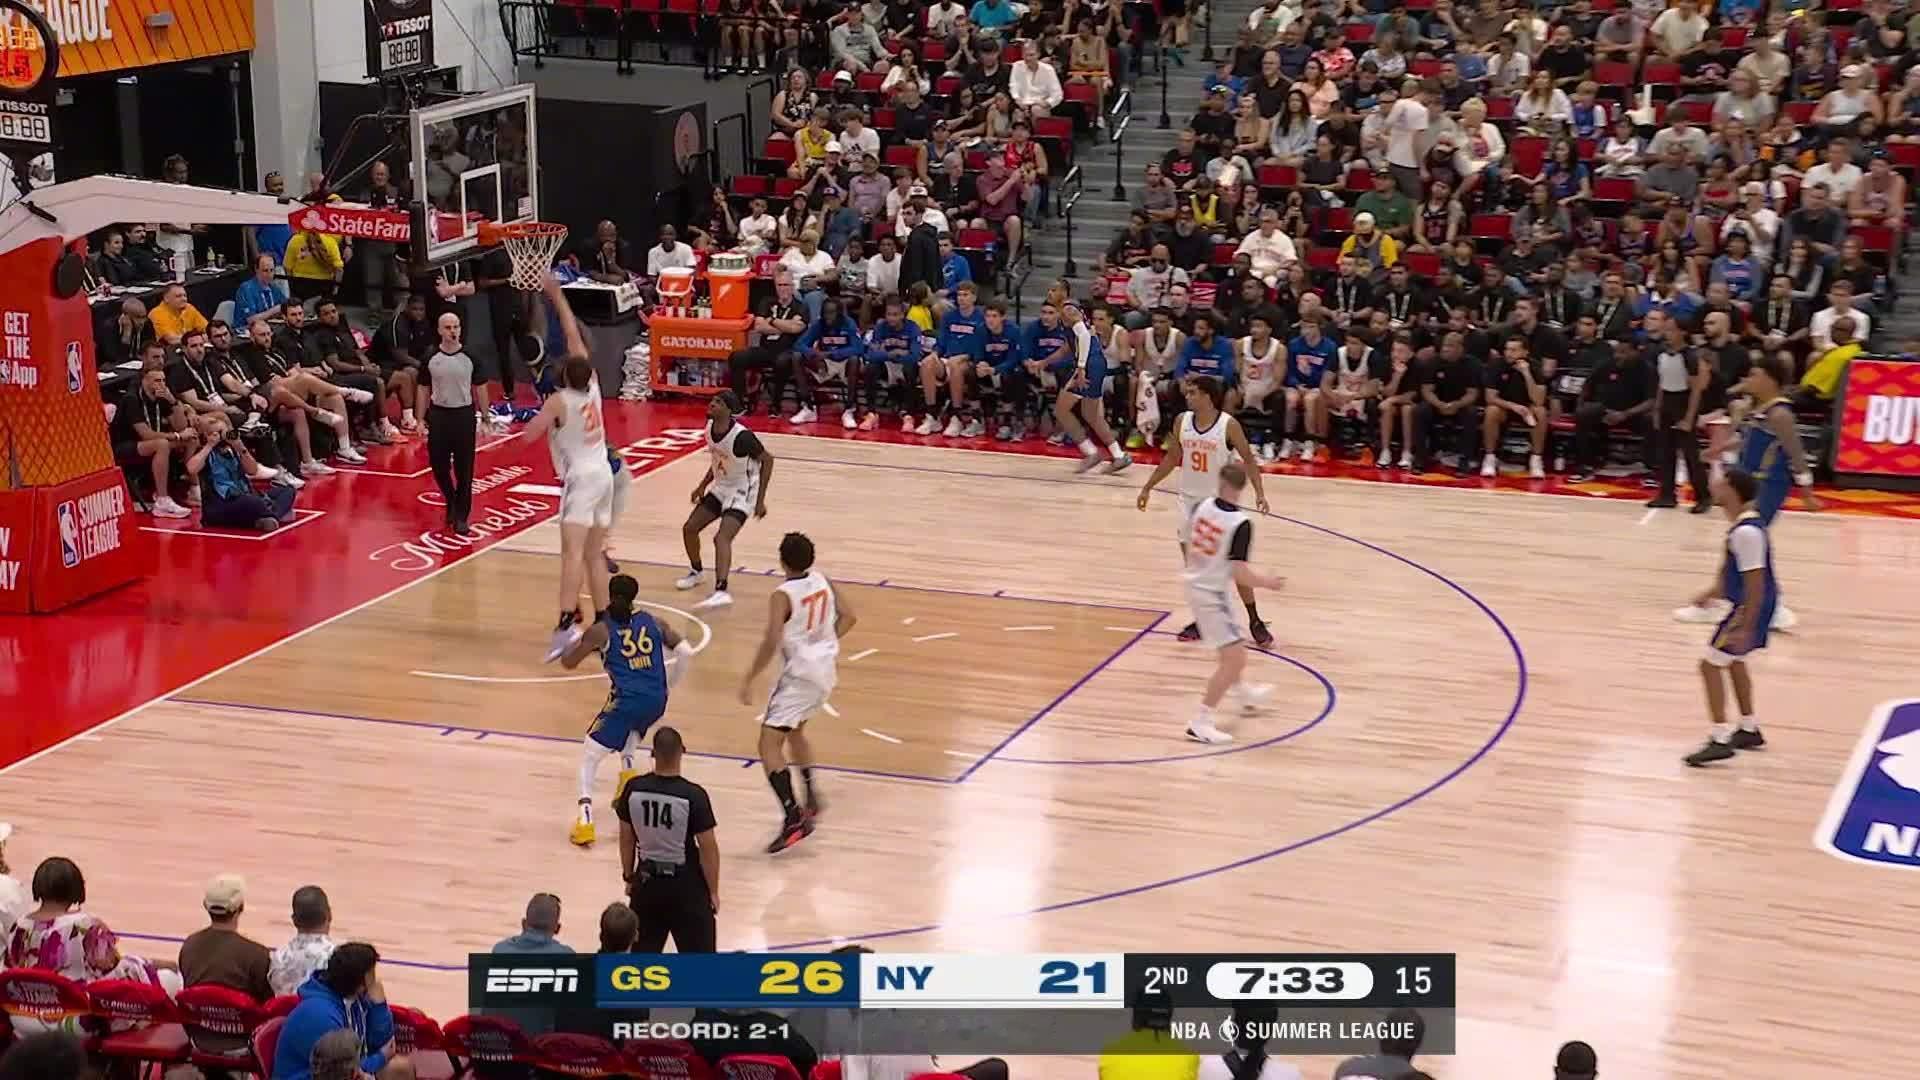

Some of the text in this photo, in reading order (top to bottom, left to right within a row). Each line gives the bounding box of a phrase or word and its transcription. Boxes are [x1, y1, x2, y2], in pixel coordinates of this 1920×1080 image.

[393, 15, 431, 36] TISSOT
[4, 311, 30, 335] GET
[4, 336, 31, 359] THE
[660, 335, 733, 351] GATORADE
[11, 361, 37, 389] App
[1191, 451, 1209, 473] 91
[78, 484, 125, 529] SUMMER
[81, 517, 121, 561] LEAGUE
[802, 589, 828, 632] 77
[616, 626, 653, 658] 36
[640, 800, 673, 830] 114
